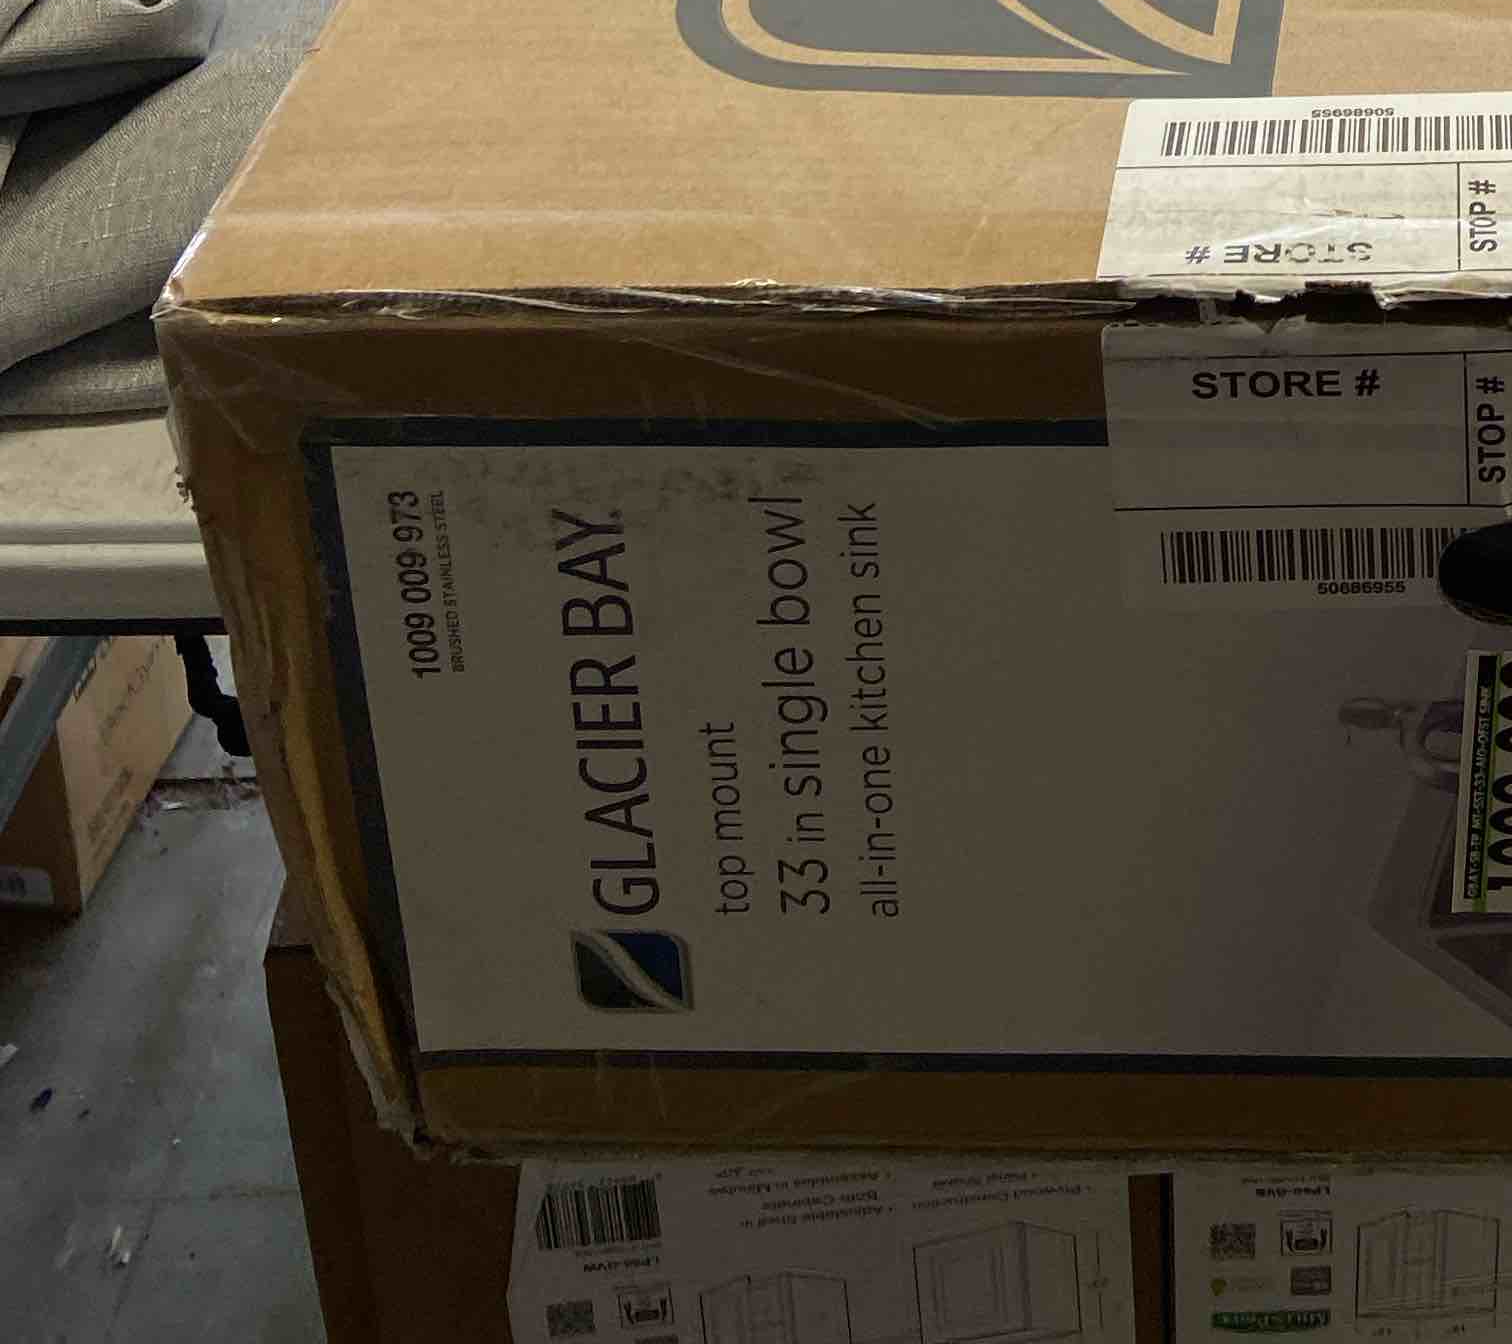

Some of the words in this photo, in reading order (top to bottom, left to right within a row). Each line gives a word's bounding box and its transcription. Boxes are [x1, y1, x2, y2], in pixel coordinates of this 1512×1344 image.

[1468, 179, 1497, 196] #
[1468, 202, 1497, 253] STOP
[1191, 370, 1343, 400] STORE
[1354, 368, 1381, 397] #
[1475, 375, 1505, 394] #
[1476, 402, 1506, 484] STOP
[388, 491, 423, 542] 973
[430, 489, 448, 531] STEEL
[837, 500, 881, 580] sink
[396, 550, 432, 604] 009
[436, 534, 457, 607] STAINLESS
[552, 508, 635, 637] BAY
[747, 496, 811, 627] bowl
[404, 612, 441, 680] 1009
[446, 610, 465, 673] BRUSHED
[845, 592, 890, 733] kitchen
[761, 646, 829, 798] single
[569, 654, 661, 916] GLACIER
[699, 720, 745, 841] mount
[786, 813, 826, 844] in
[858, 745, 899, 919] all-in-one
[714, 855, 756, 918] top
[776, 859, 831, 915] 33
